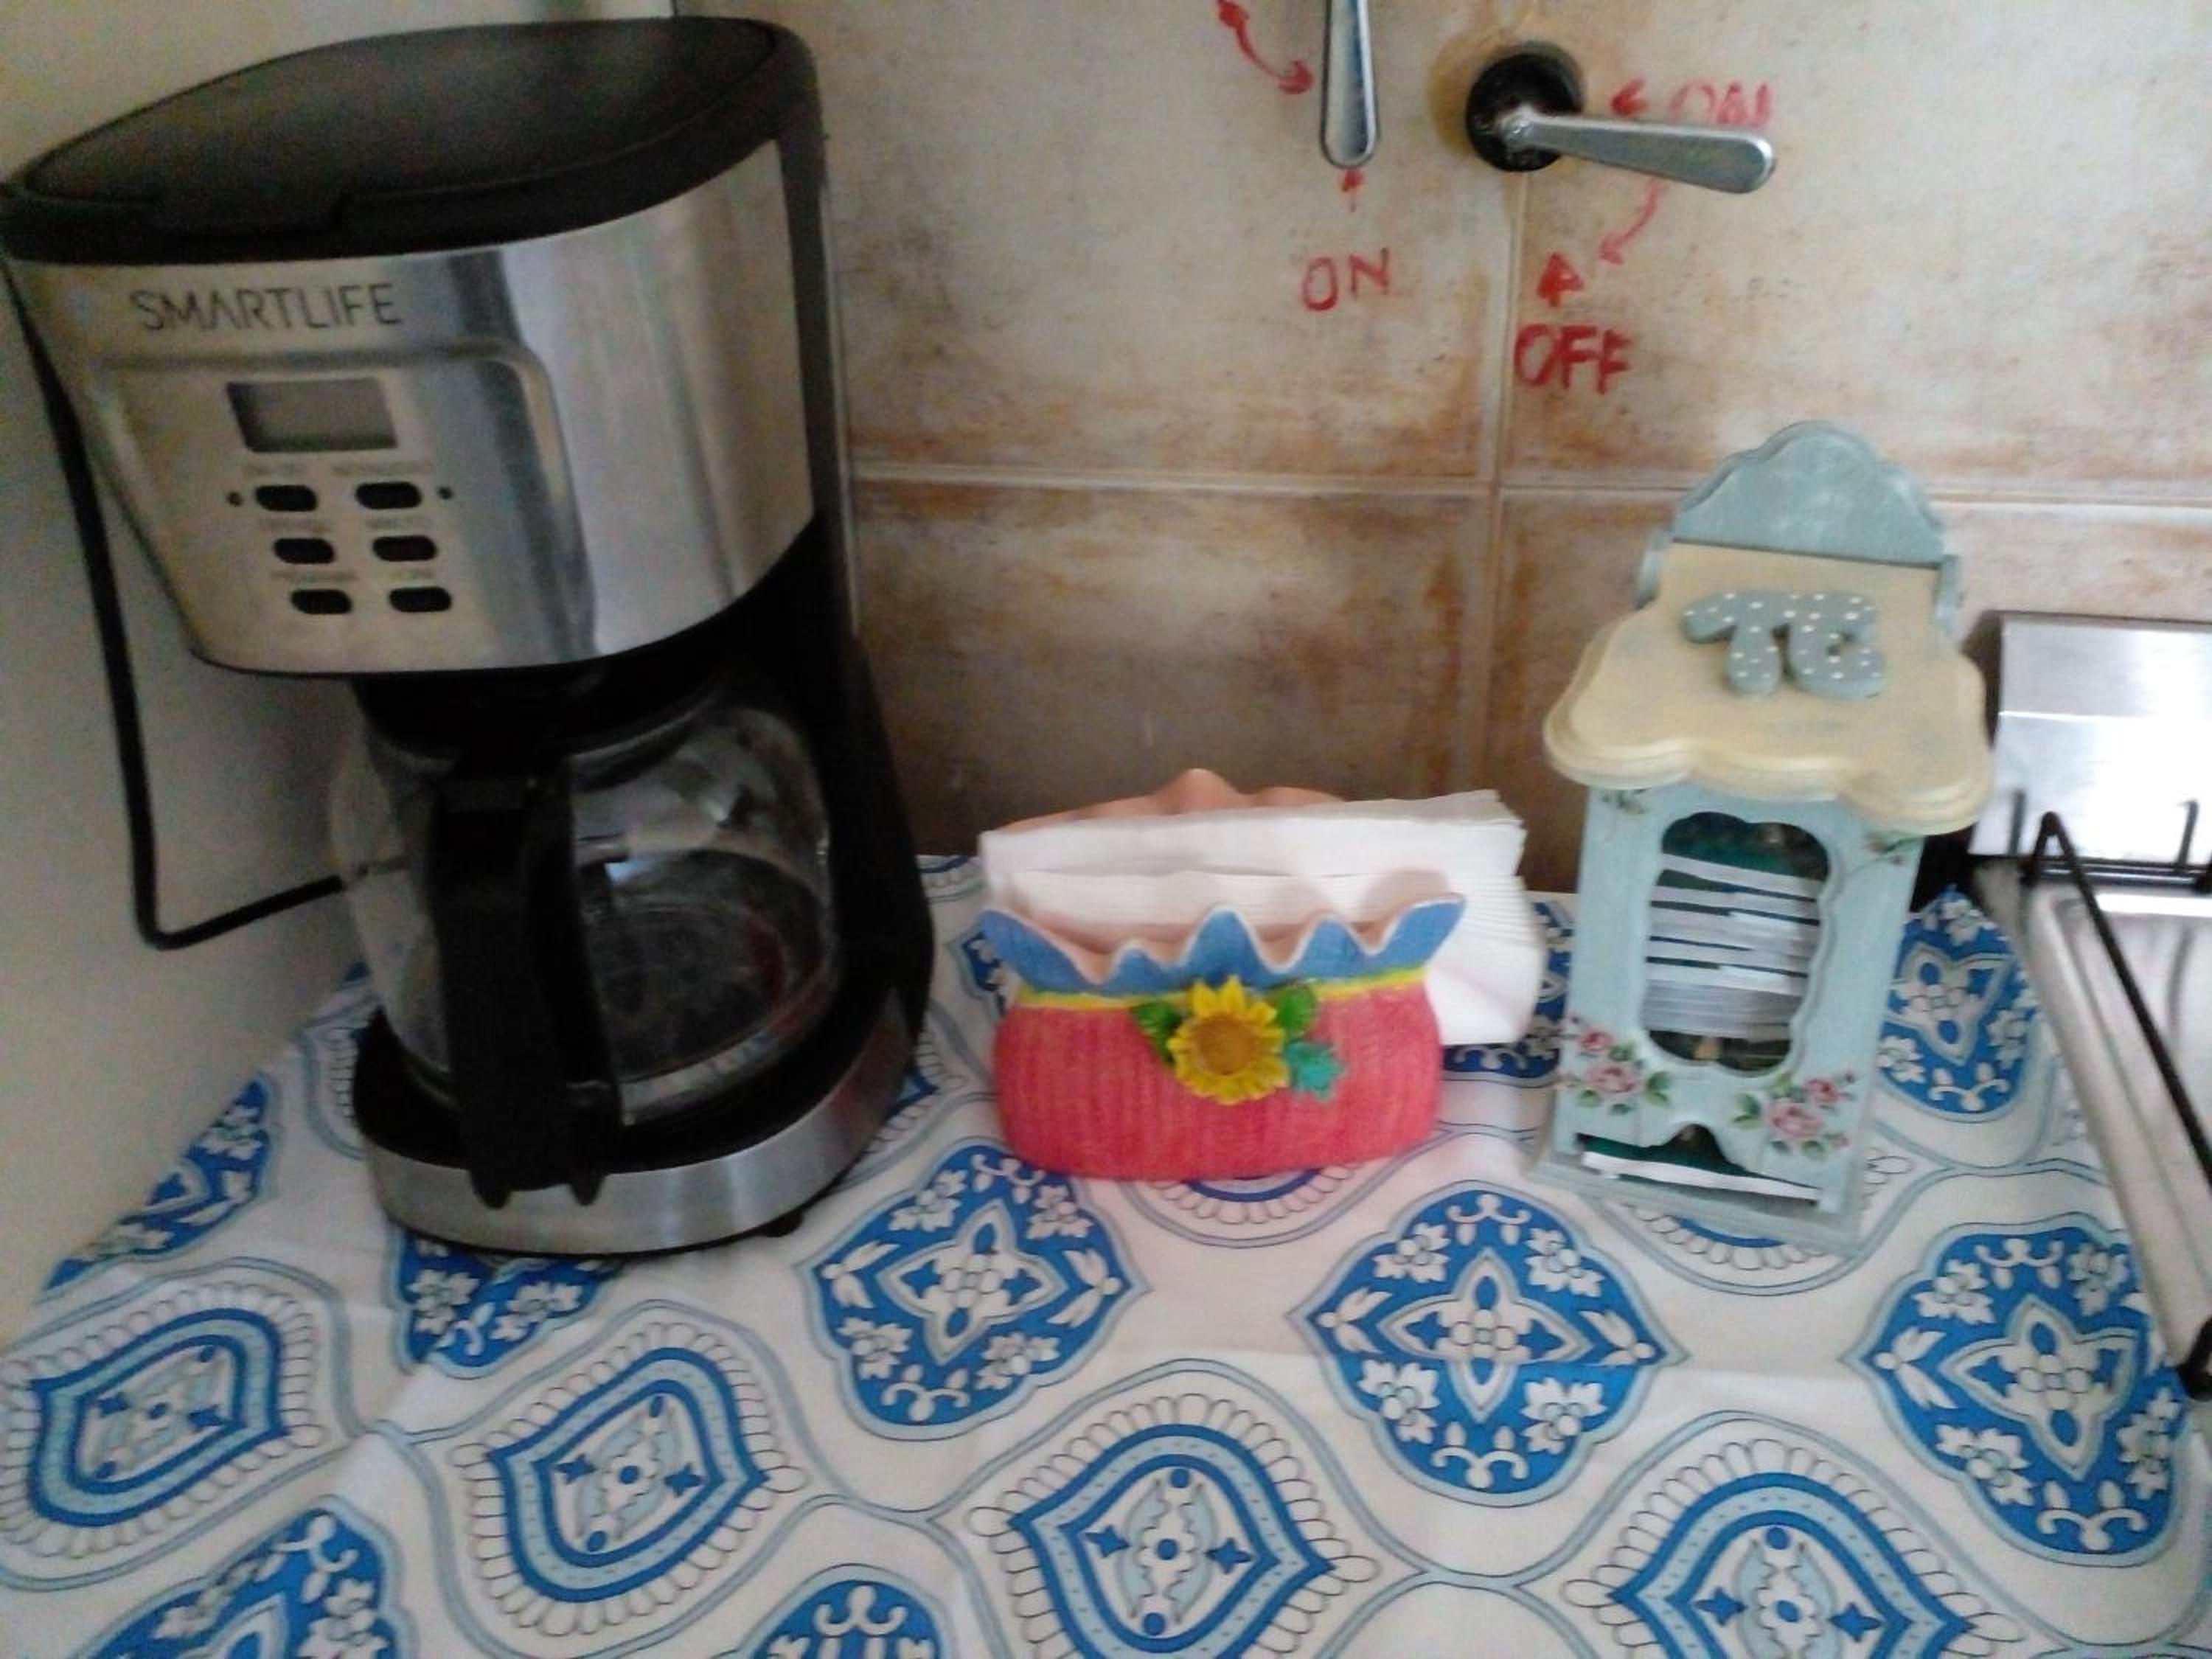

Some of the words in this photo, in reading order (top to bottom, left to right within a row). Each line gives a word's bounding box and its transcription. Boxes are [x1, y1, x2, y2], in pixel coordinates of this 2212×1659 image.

[131, 282, 403, 331] SMARTLIFE
[1302, 247, 1389, 312] ON
[1514, 323, 1633, 395] OFF
